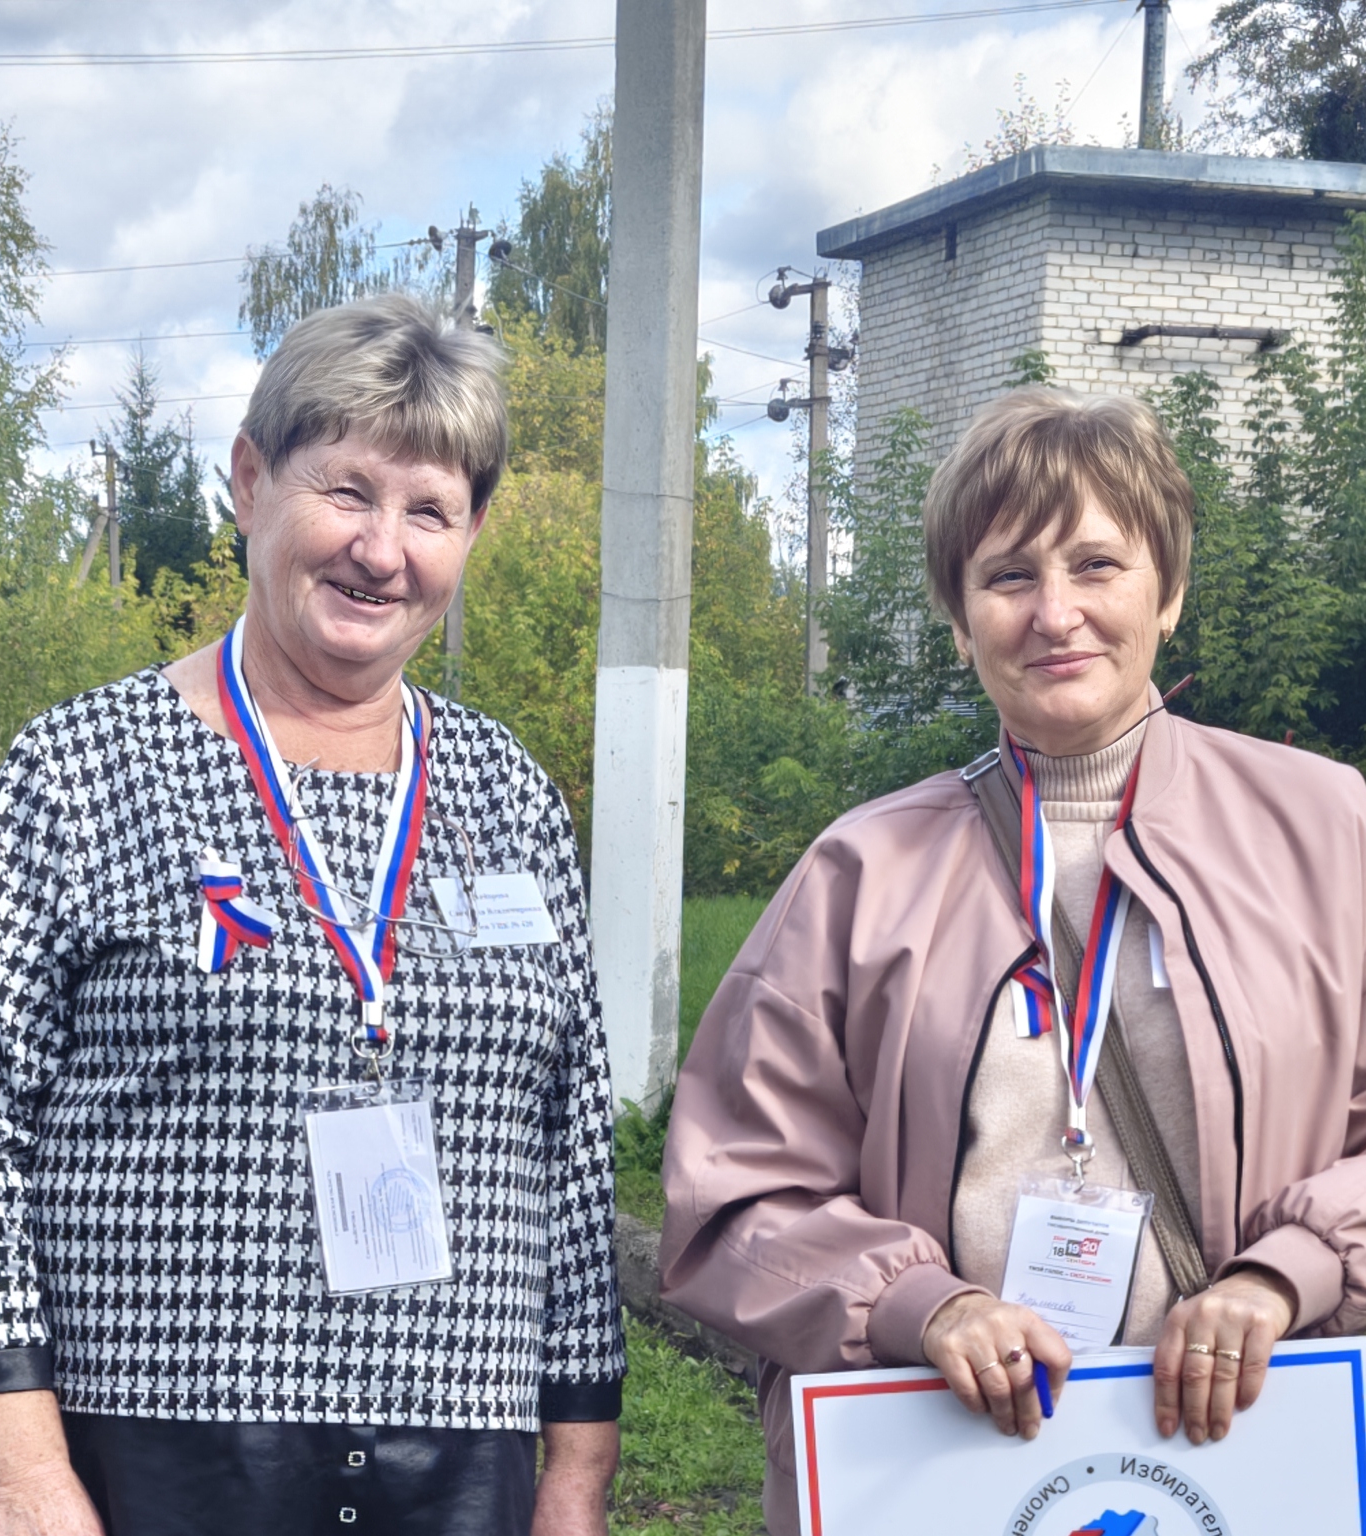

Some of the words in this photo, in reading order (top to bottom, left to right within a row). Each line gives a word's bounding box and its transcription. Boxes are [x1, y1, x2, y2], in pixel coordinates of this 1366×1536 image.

[1053, 1246, 1064, 1257] 18
[1068, 1243, 1079, 1254] 19
[1083, 1240, 1097, 1252] 20
